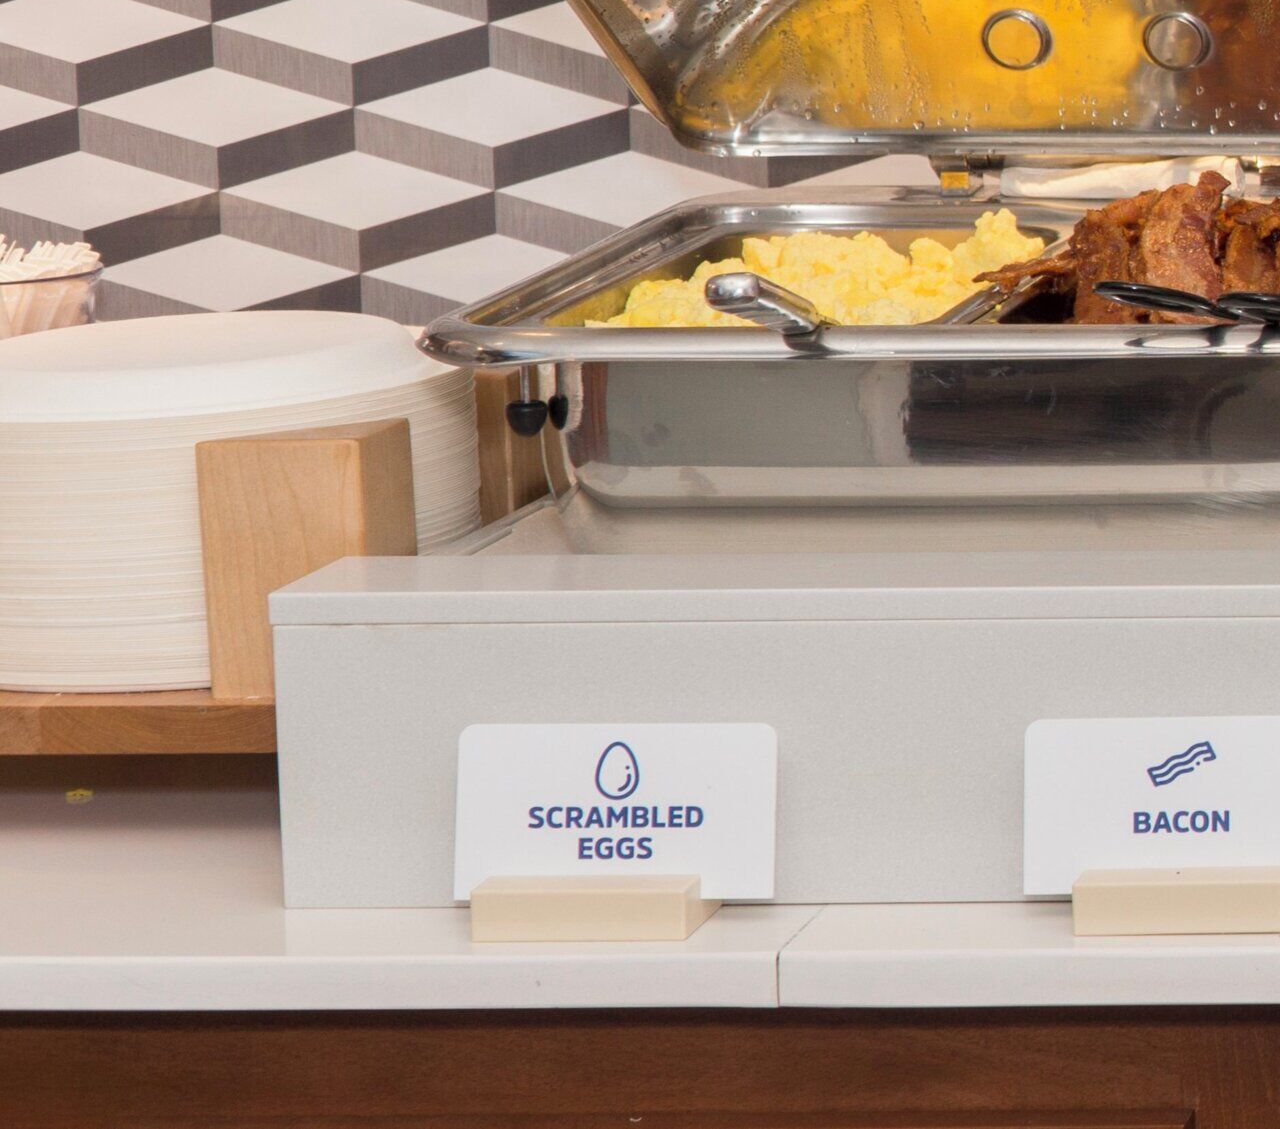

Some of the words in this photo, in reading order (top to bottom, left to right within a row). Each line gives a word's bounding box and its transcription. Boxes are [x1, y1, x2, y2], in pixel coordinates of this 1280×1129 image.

[527, 805, 705, 830] SCRAMBLED
[1132, 810, 1231, 834] BACON
[577, 836, 654, 861] EGGS
